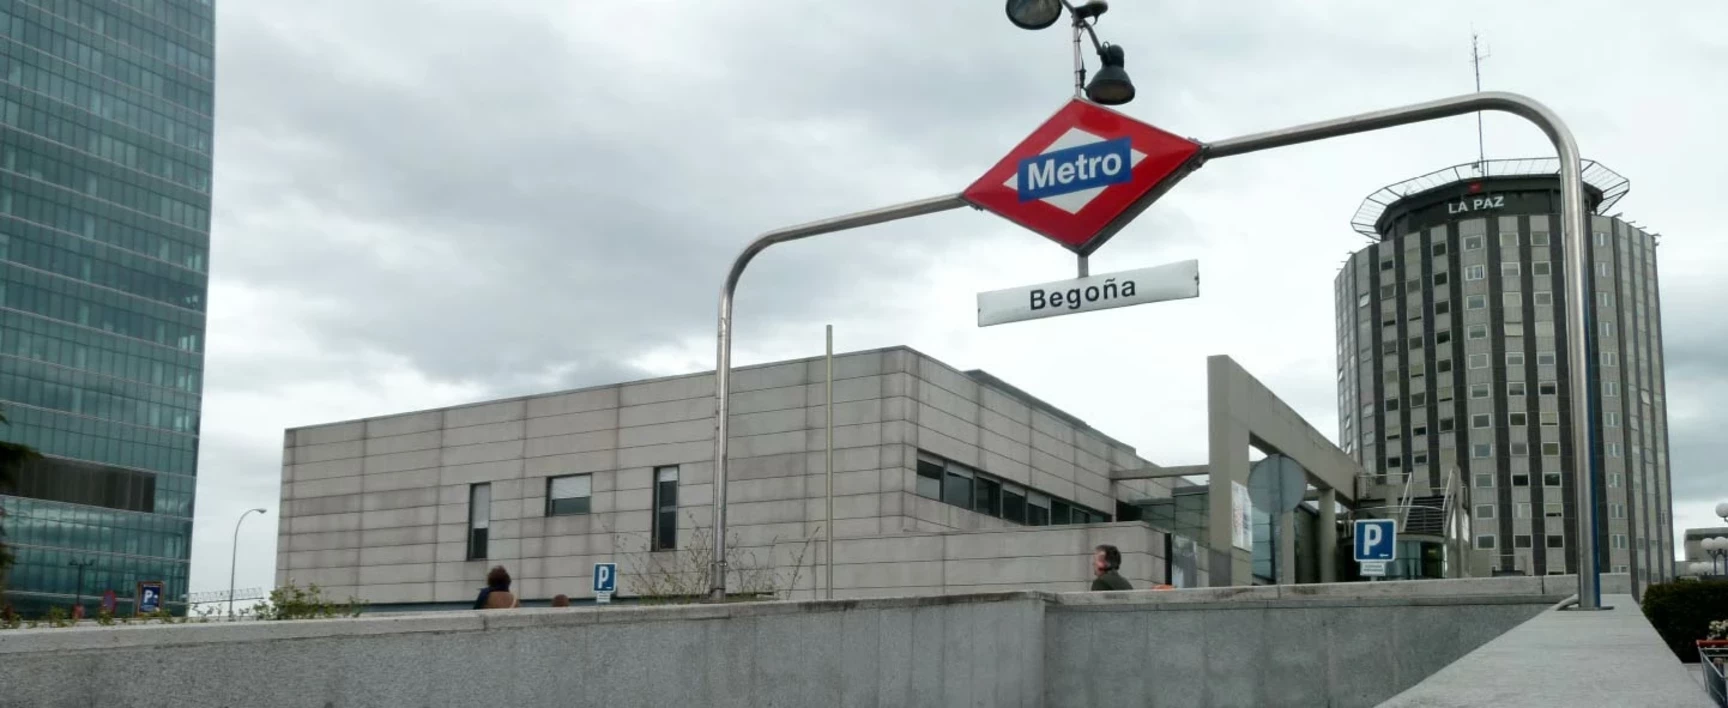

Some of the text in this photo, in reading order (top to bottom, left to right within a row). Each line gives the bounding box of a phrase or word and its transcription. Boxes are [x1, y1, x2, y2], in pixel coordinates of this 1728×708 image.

[1028, 152, 1122, 190] Metro
[1448, 196, 1504, 214] LA PAZ
[1030, 278, 1136, 310] Begoña
[1363, 523, 1382, 556] P
[598, 565, 610, 589] P
[144, 590, 153, 603] P
